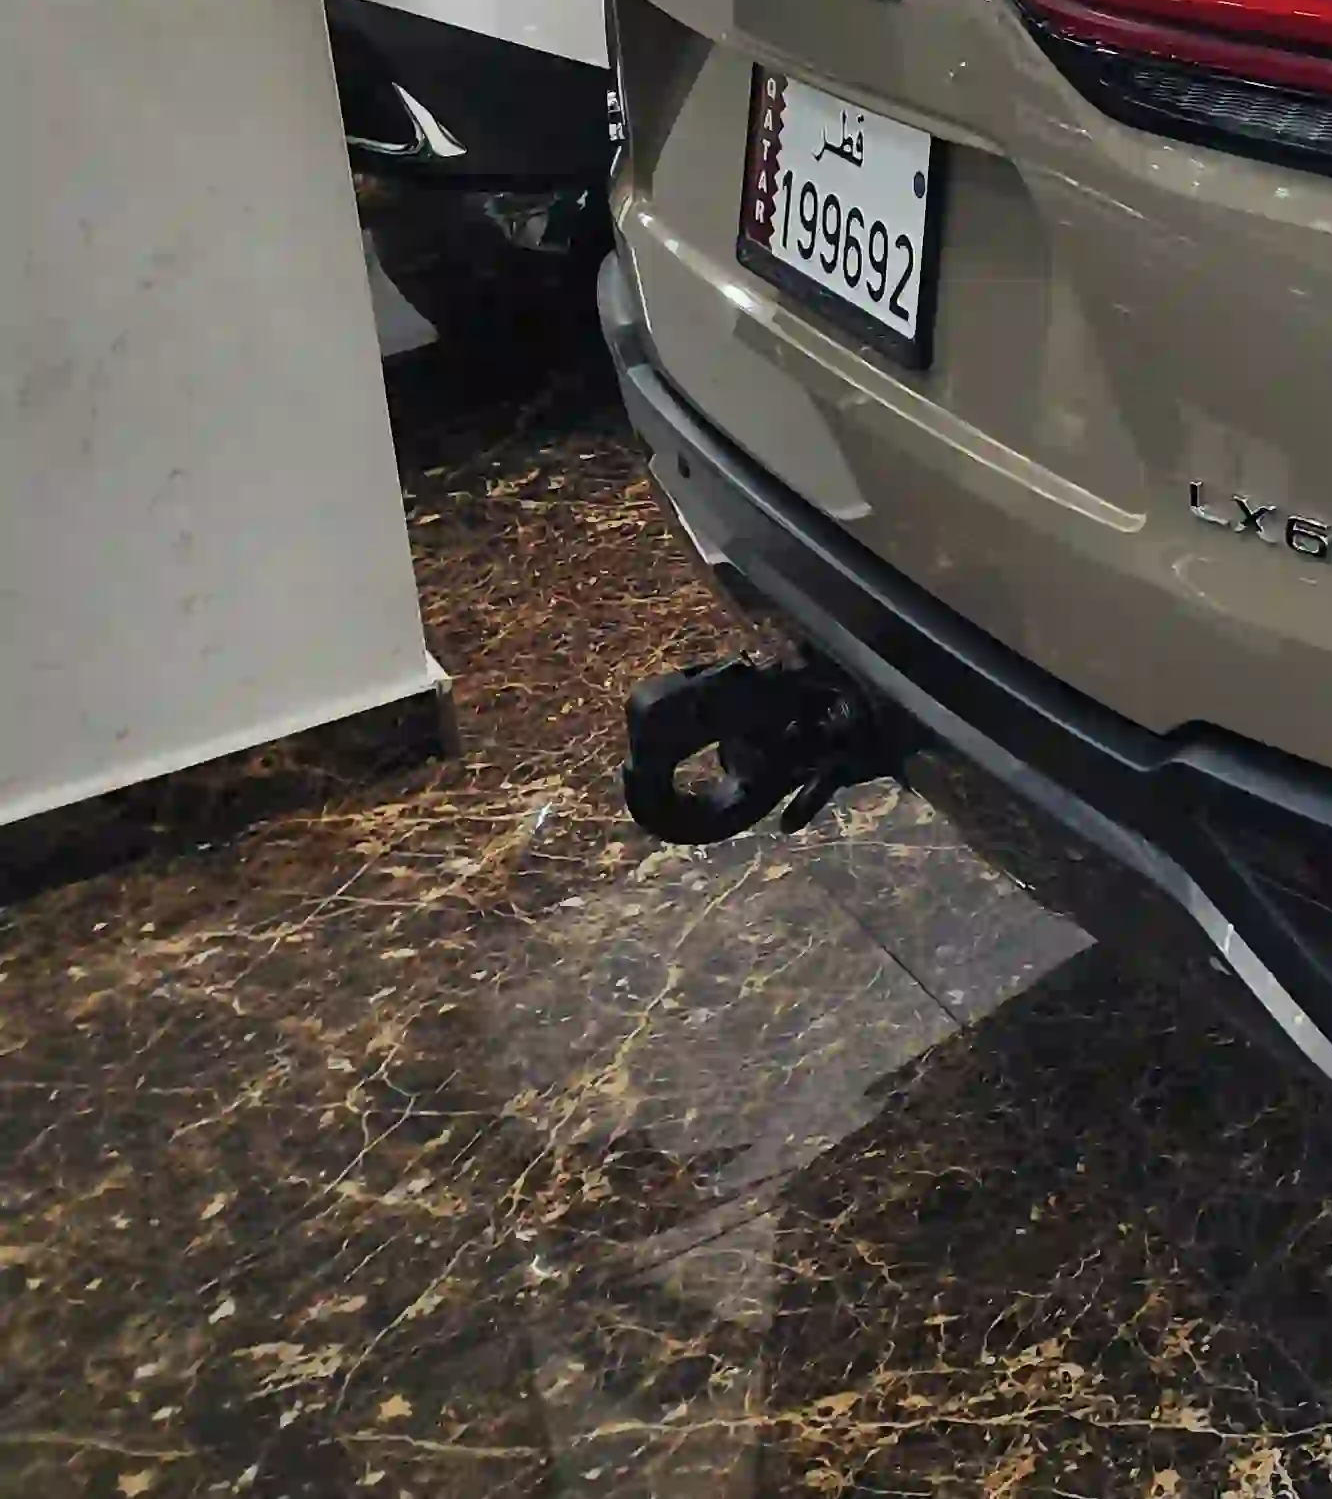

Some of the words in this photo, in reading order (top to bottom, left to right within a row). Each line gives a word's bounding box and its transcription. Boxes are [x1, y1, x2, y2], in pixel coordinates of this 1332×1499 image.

[754, 77, 777, 224] QATAR
[812, 110, 865, 169] قطر
[780, 169, 916, 322] 199692
